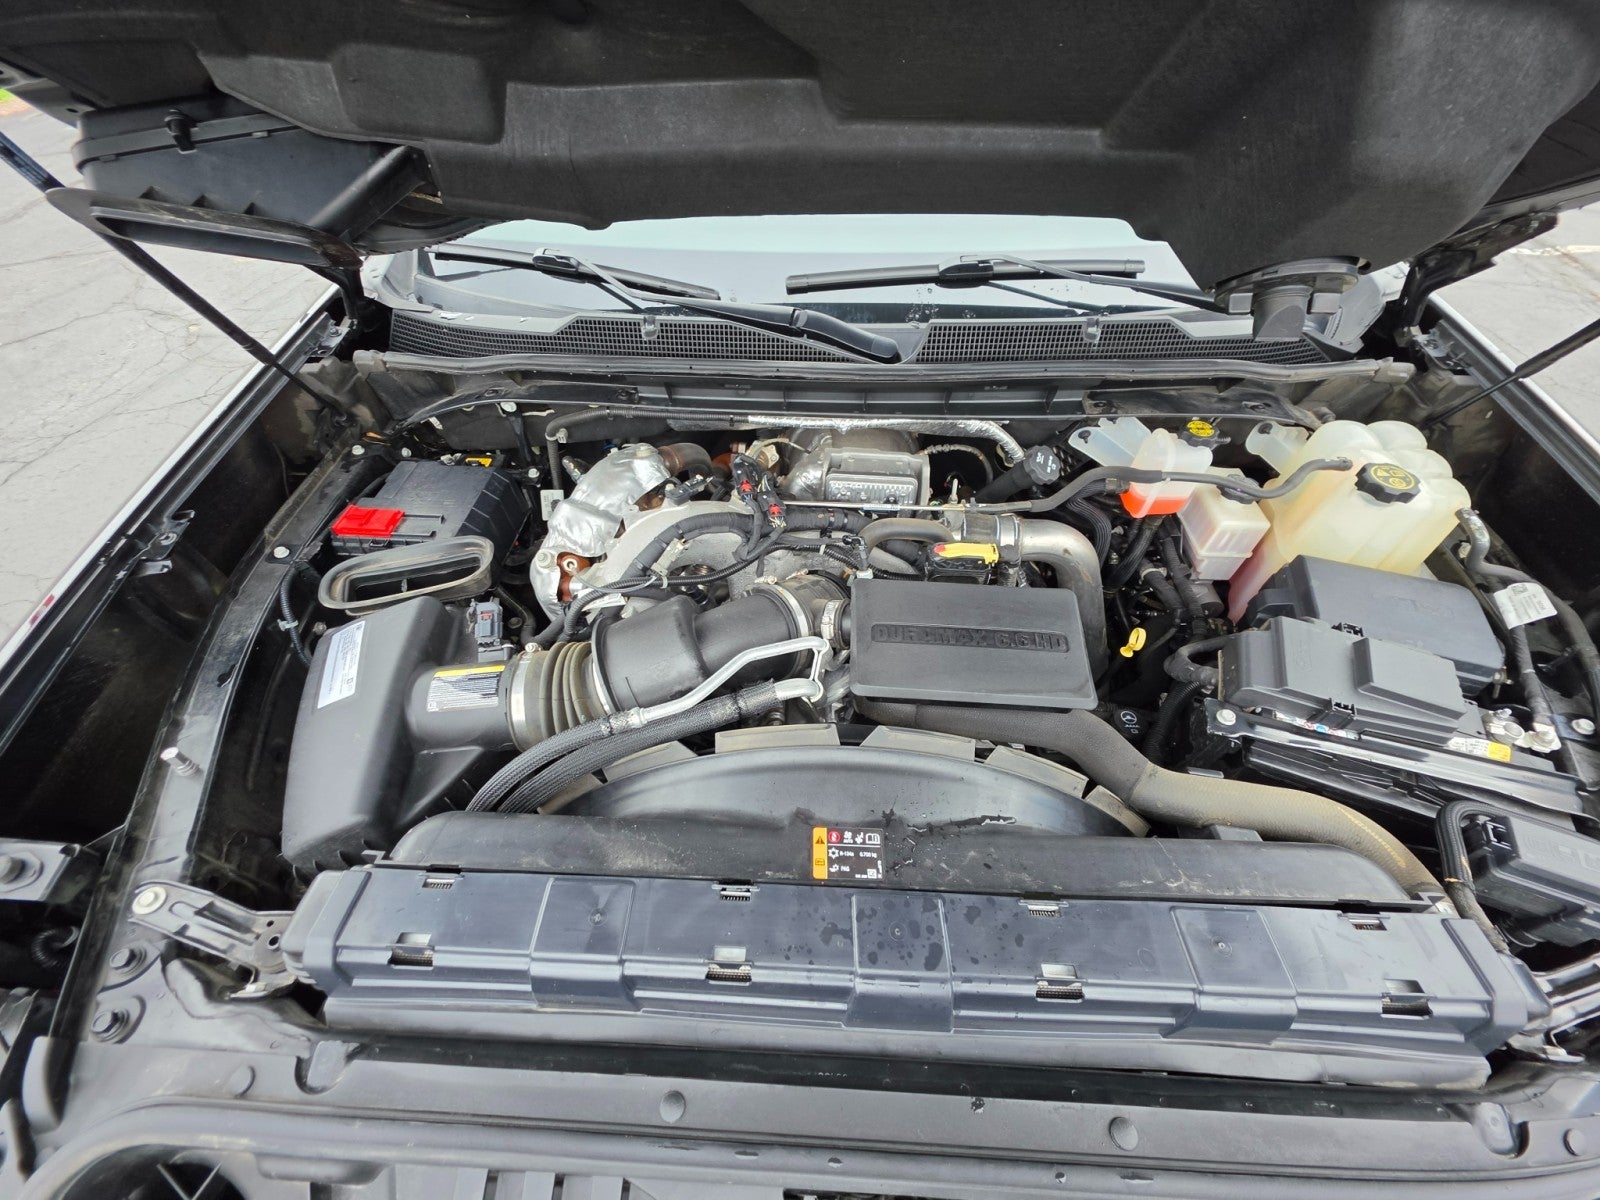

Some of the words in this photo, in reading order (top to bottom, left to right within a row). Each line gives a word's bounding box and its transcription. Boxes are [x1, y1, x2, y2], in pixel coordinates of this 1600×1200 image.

[875, 625, 986, 646] DURAMAX
[994, 631, 1030, 648] 6.6
[1034, 633, 1069, 652] HD
